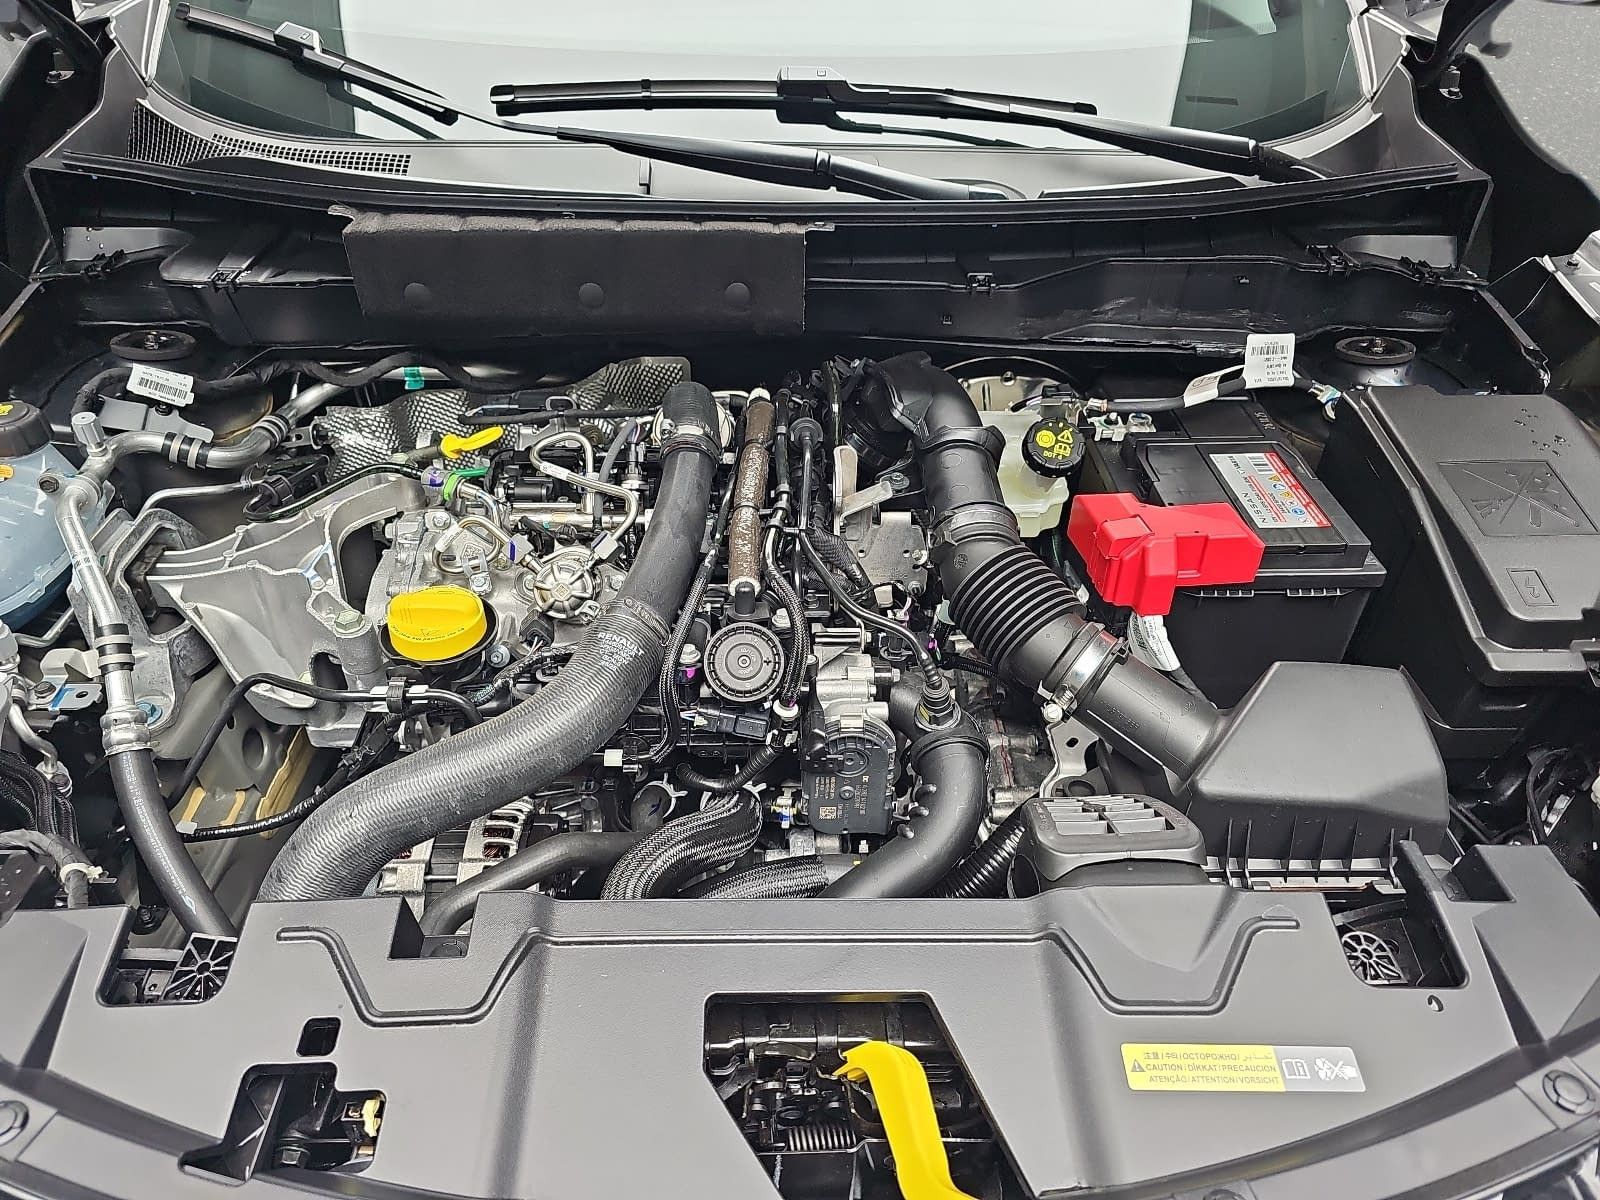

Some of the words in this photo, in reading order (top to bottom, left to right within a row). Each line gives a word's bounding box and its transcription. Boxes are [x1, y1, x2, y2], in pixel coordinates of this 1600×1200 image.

[1242, 492, 1269, 524] NISSAN
[598, 632, 644, 656] RENAULT
[1146, 1063, 1183, 1071] CAUTION
[1238, 1076, 1280, 1084] VORSICHT
